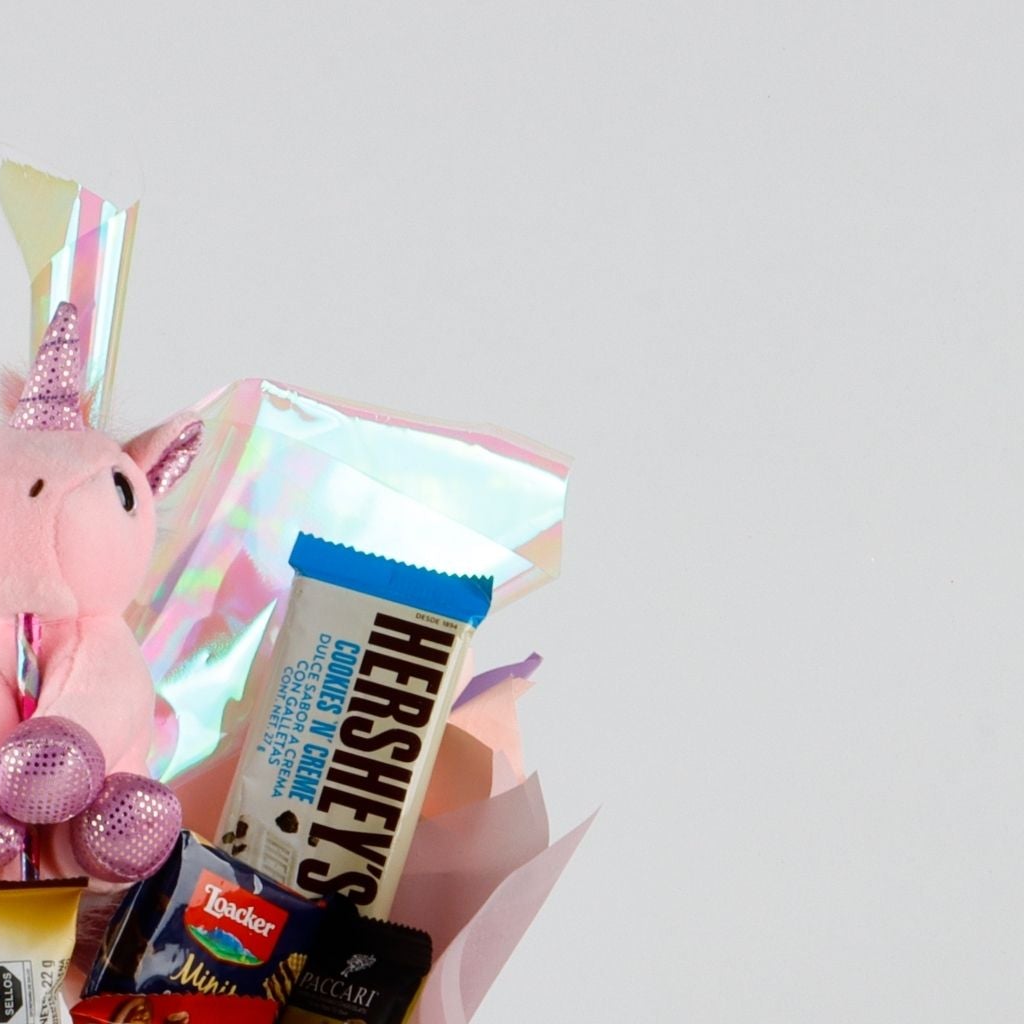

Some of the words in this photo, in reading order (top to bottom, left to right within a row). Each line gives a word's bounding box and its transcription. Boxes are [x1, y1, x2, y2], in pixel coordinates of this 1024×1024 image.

[288, 658, 309, 695] CON
[307, 632, 331, 682] DULCE
[315, 637, 361, 715] COOKIES
[274, 665, 294, 703] CONT.
[265, 703, 282, 730] NET.
[292, 683, 316, 732] SABOR
[261, 731, 273, 745] 27
[267, 695, 297, 767] GALLETAS
[287, 734, 300, 746] A
[271, 747, 296, 799] CREMA
[288, 741, 328, 804] CREME
[296, 612, 455, 906] HERSHEY'S
[204, 883, 276, 938] Loacker
[3, 973, 14, 1016] SELLOS
[41, 971, 54, 992] 22
[299, 971, 378, 1008] PACCARI
